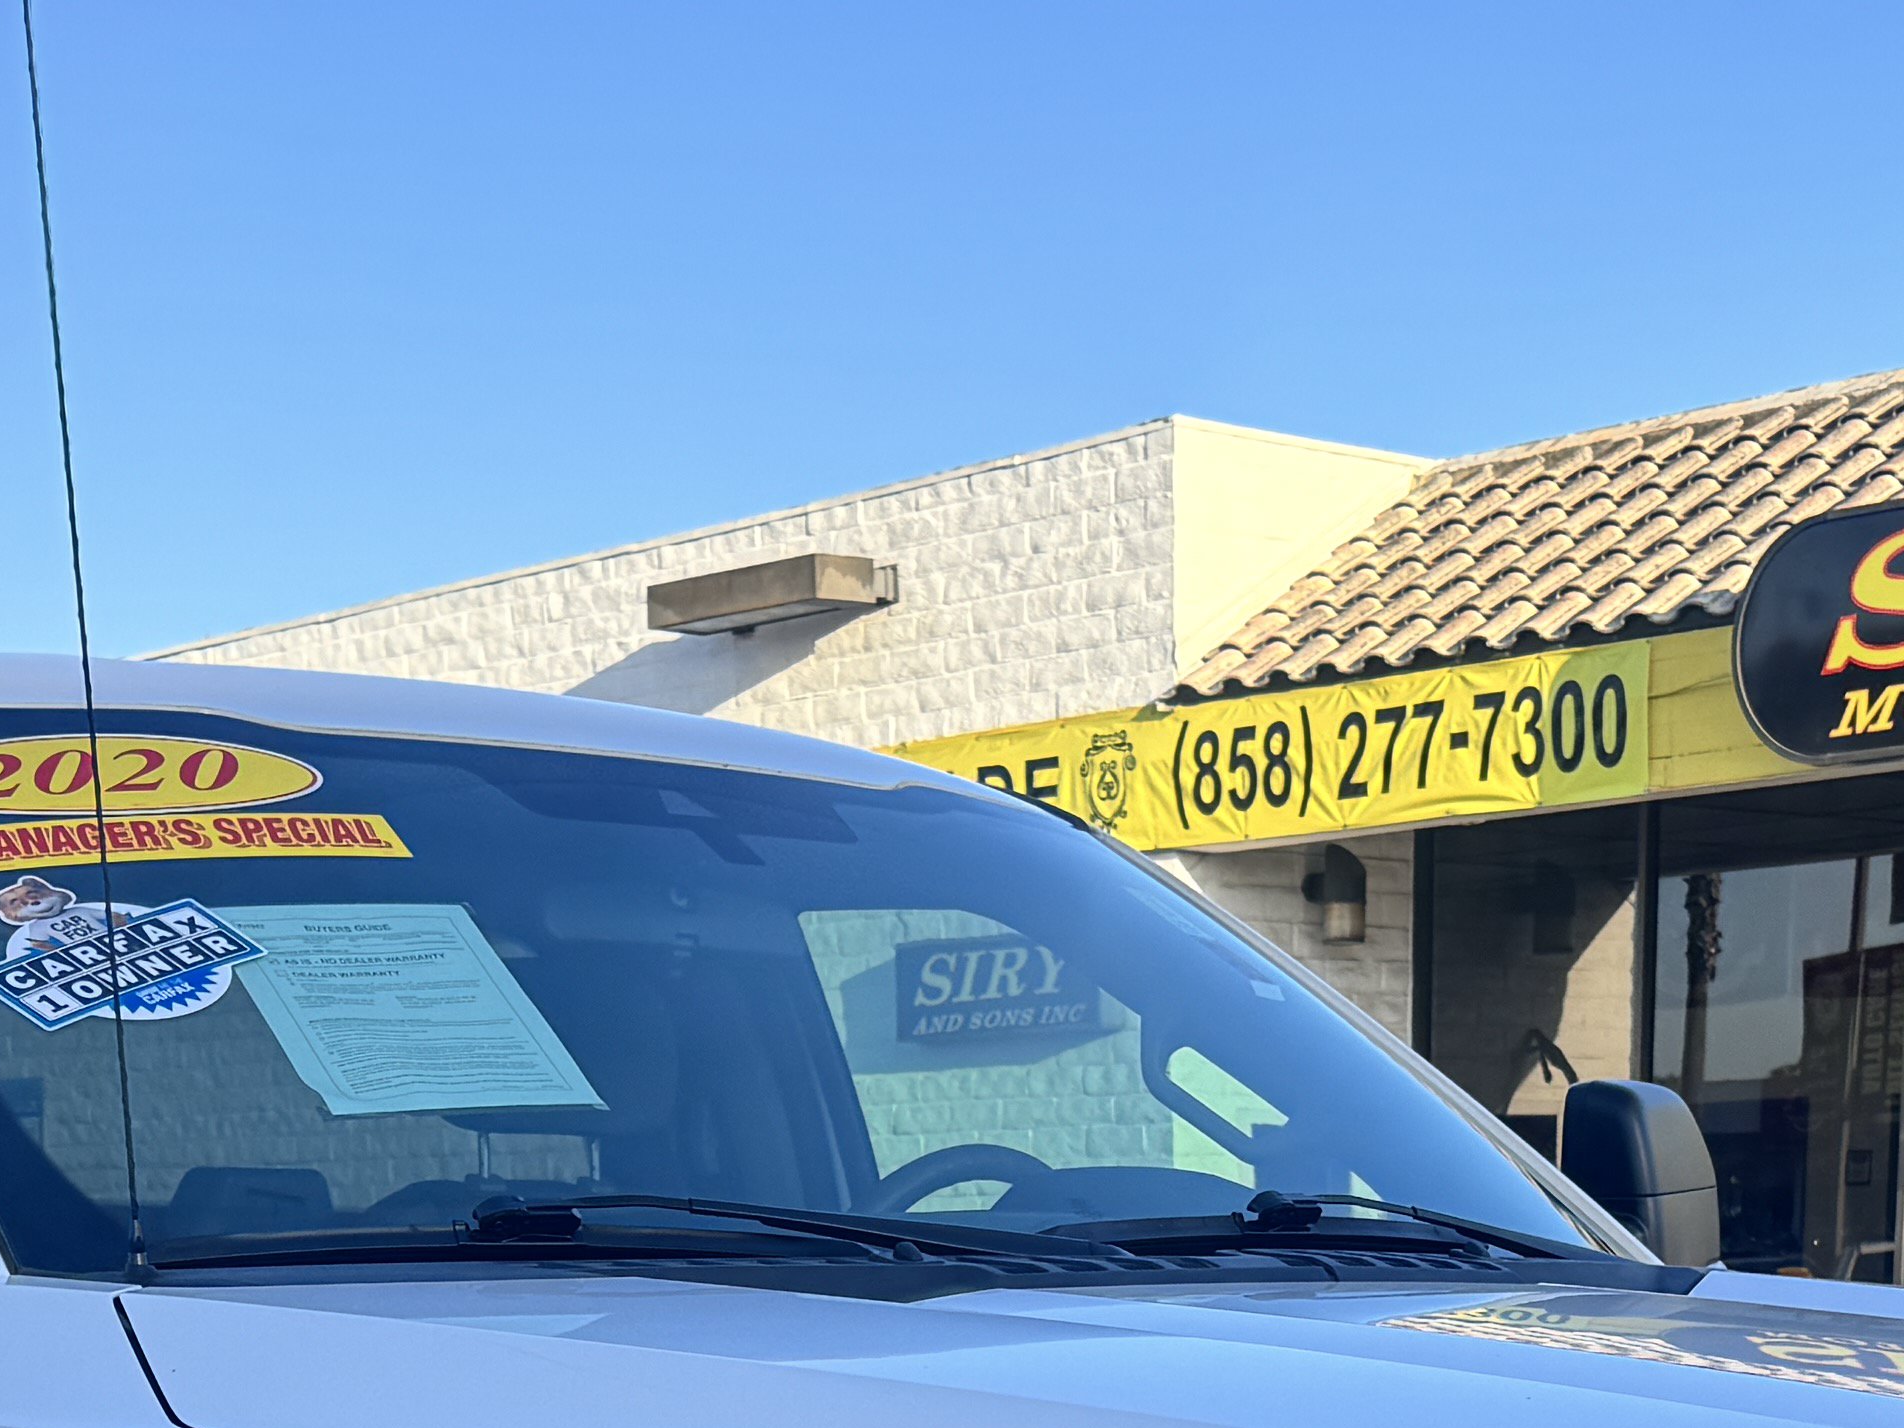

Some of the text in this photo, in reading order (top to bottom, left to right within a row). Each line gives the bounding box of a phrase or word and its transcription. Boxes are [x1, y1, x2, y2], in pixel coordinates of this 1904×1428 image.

[1172, 673, 1630, 830] (858) 277-7300
[214, 817, 393, 849] SPECIAL
[50, 915, 87, 933] CAR
[65, 925, 99, 941] FOX
[4, 915, 210, 990] CARFAX
[37, 991, 70, 1014] 1
[71, 934, 238, 999] OWNER
[913, 945, 1066, 1007] SIRY
[912, 1003, 1086, 1036] AND SONS INC
